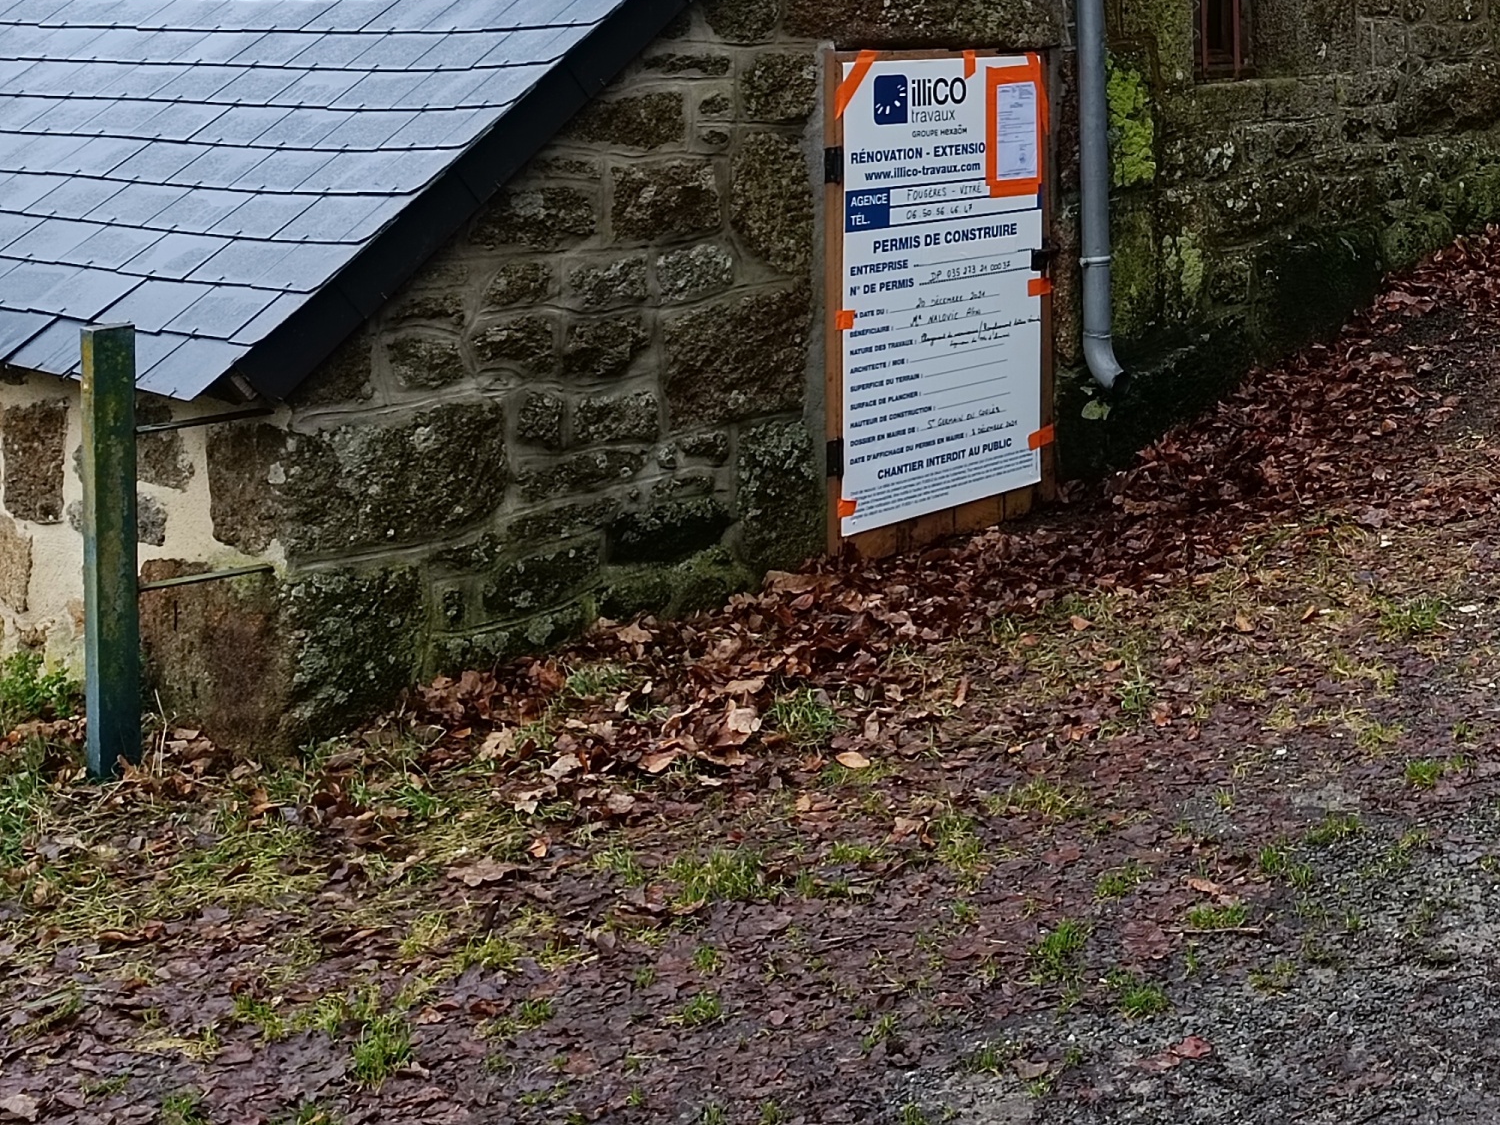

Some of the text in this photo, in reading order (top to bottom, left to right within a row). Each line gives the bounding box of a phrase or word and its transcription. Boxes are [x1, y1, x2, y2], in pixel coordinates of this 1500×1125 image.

[911, 76, 967, 107] illiCO
[911, 109, 956, 124] travaux
[911, 129, 939, 138] GROUPE
[850, 147, 923, 165] RÉNOVATION
[933, 141, 986, 158] EXTENSIO
[864, 162, 981, 181] www.illico-travaux.com
[850, 193, 888, 207] AGENCE
[906, 187, 947, 201] FOUGÈRES
[960, 182, 982, 195] VITRÉ
[850, 211, 871, 226] TÉL.
[873, 223, 1018, 254] PERMIS DE CONSTRUIRE
[850, 259, 909, 276] ENTREPRISE
[849, 278, 914, 297] N° DE PERMIS
[859, 309, 875, 319] DATE
[876, 307, 885, 316] DU
[849, 346, 873, 356] NATURE
[874, 343, 886, 352] DES
[888, 339, 914, 350] TRAVAUX
[849, 361, 887, 374] ARCHITECTE
[850, 380, 884, 392] SUPERFICIE
[885, 378, 894, 386] DU
[895, 373, 919, 383] TERRAIN
[850, 399, 877, 411] SURFACE
[878, 397, 886, 405] DE
[888, 391, 918, 403] PLANCHER
[849, 417, 878, 429] HAUTEUR
[889, 405, 932, 420] CONSTRUCTION
[850, 435, 876, 447] DOSSIER
[877, 433, 885, 441] EN
[886, 428, 906, 439] MAIRIE
[849, 455, 865, 465] DATE
[867, 446, 904, 460] D'AFFICHAGE
[905, 444, 914, 452] DU
[915, 439, 936, 450] PERMIS
[937, 436, 944, 444] EN
[945, 432, 964, 442] MAIRIE
[877, 437, 1013, 480] CHANTIER INTERDIT AU PUBLIC
